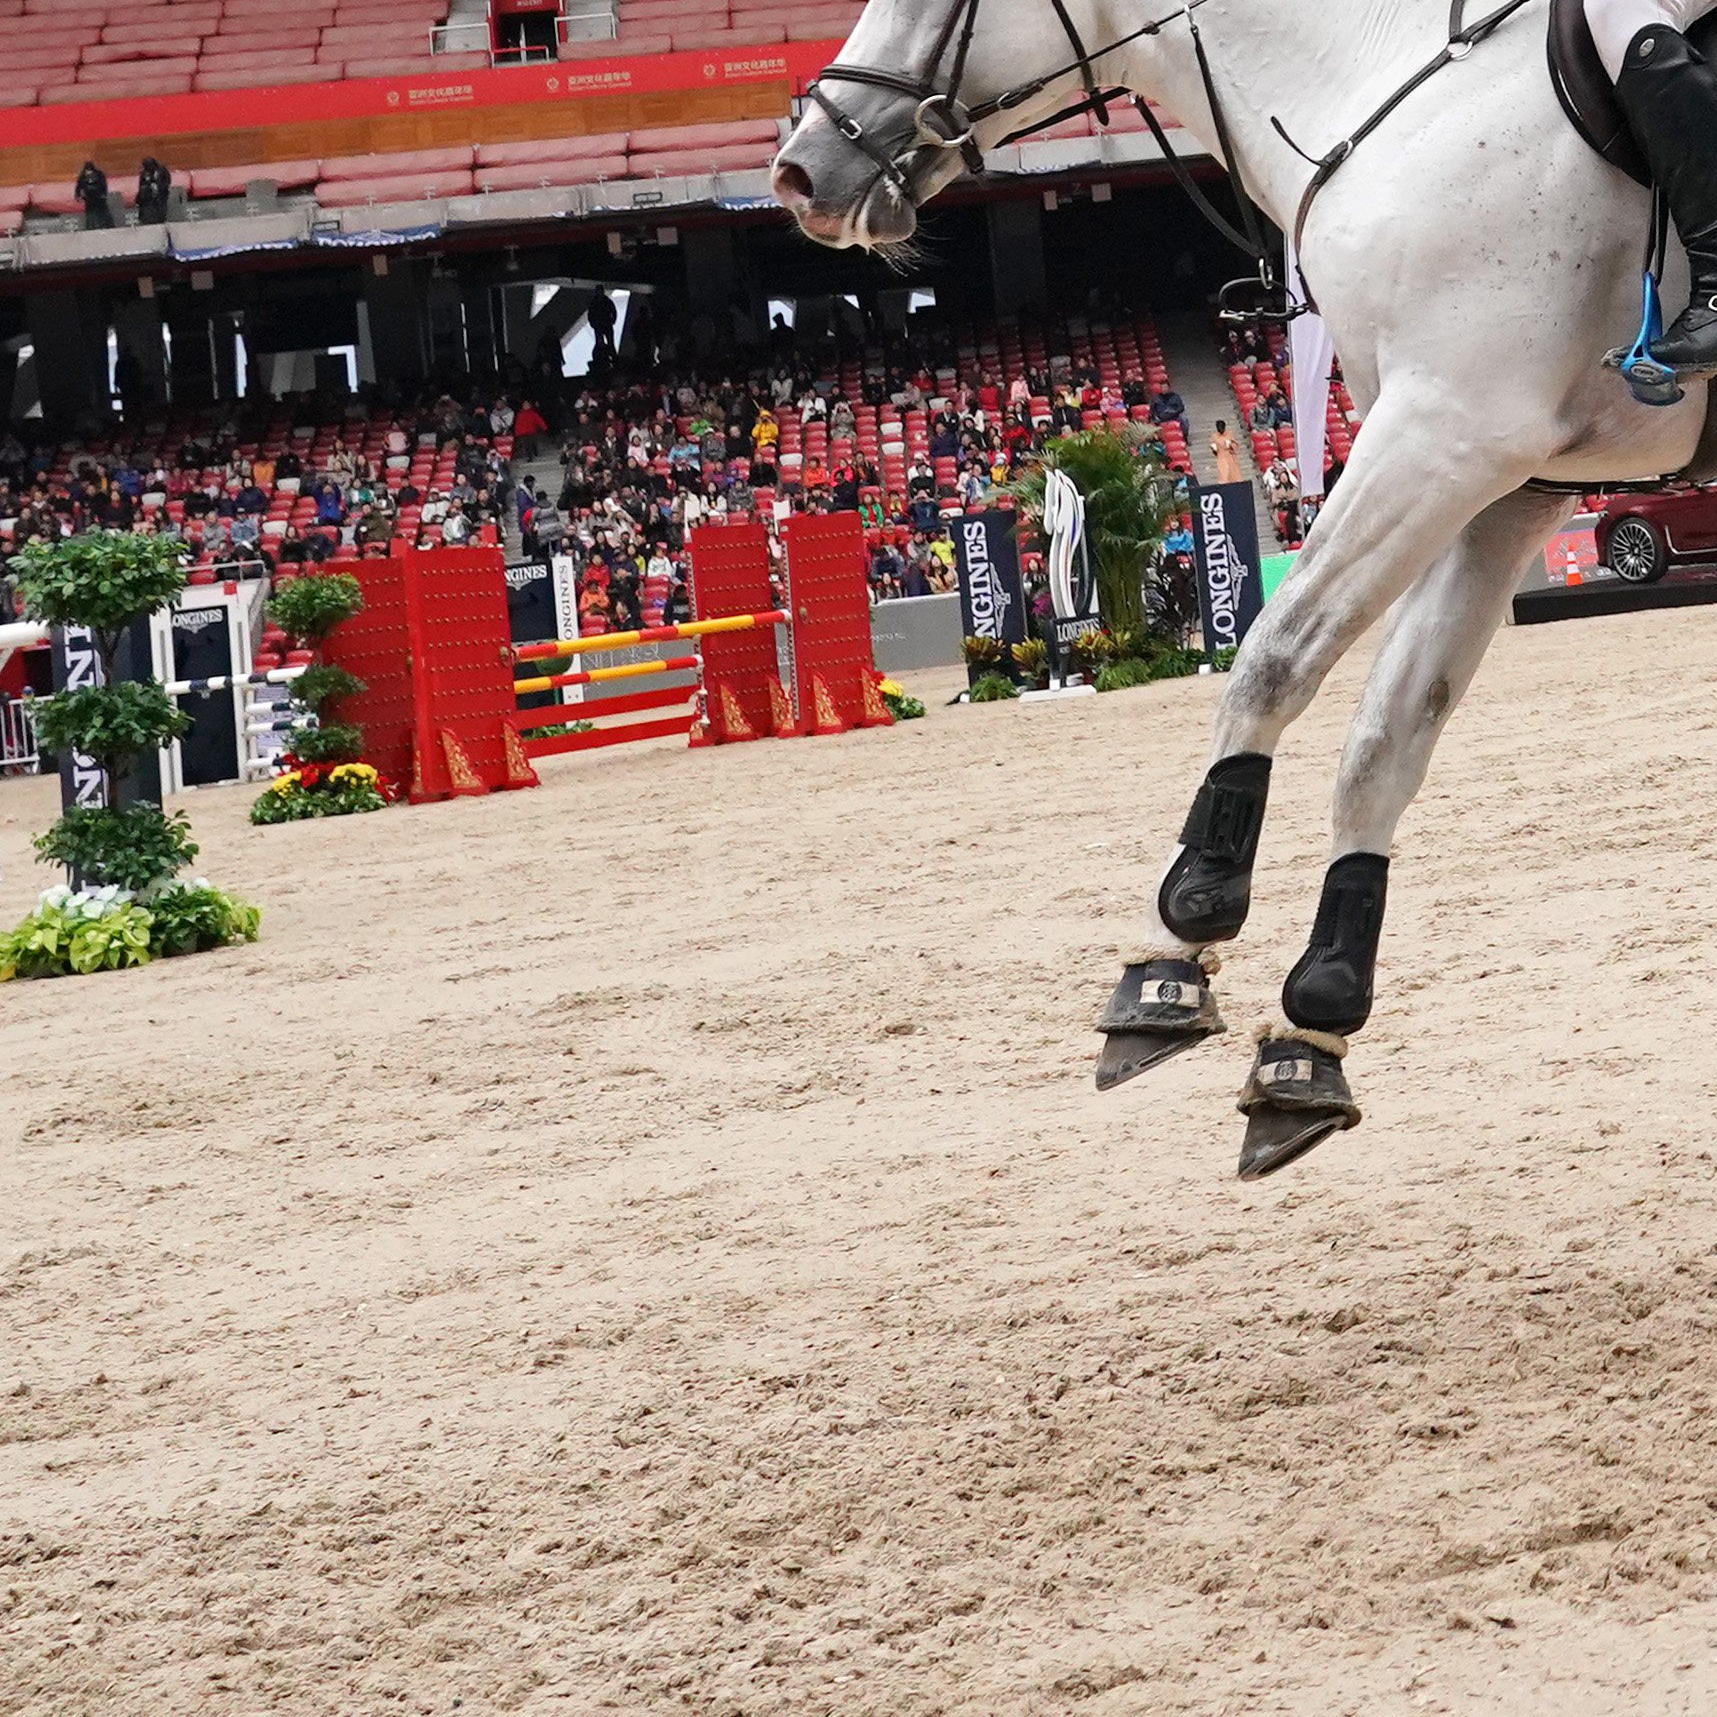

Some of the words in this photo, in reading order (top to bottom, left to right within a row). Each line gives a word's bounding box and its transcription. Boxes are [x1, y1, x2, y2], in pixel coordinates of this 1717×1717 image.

[506, 564, 548, 584] NGINES
[559, 564, 577, 641] ONGINES
[964, 520, 997, 639] NGINES
[1201, 492, 1239, 651] LONGINES
[172, 609, 224, 629] ONGINES
